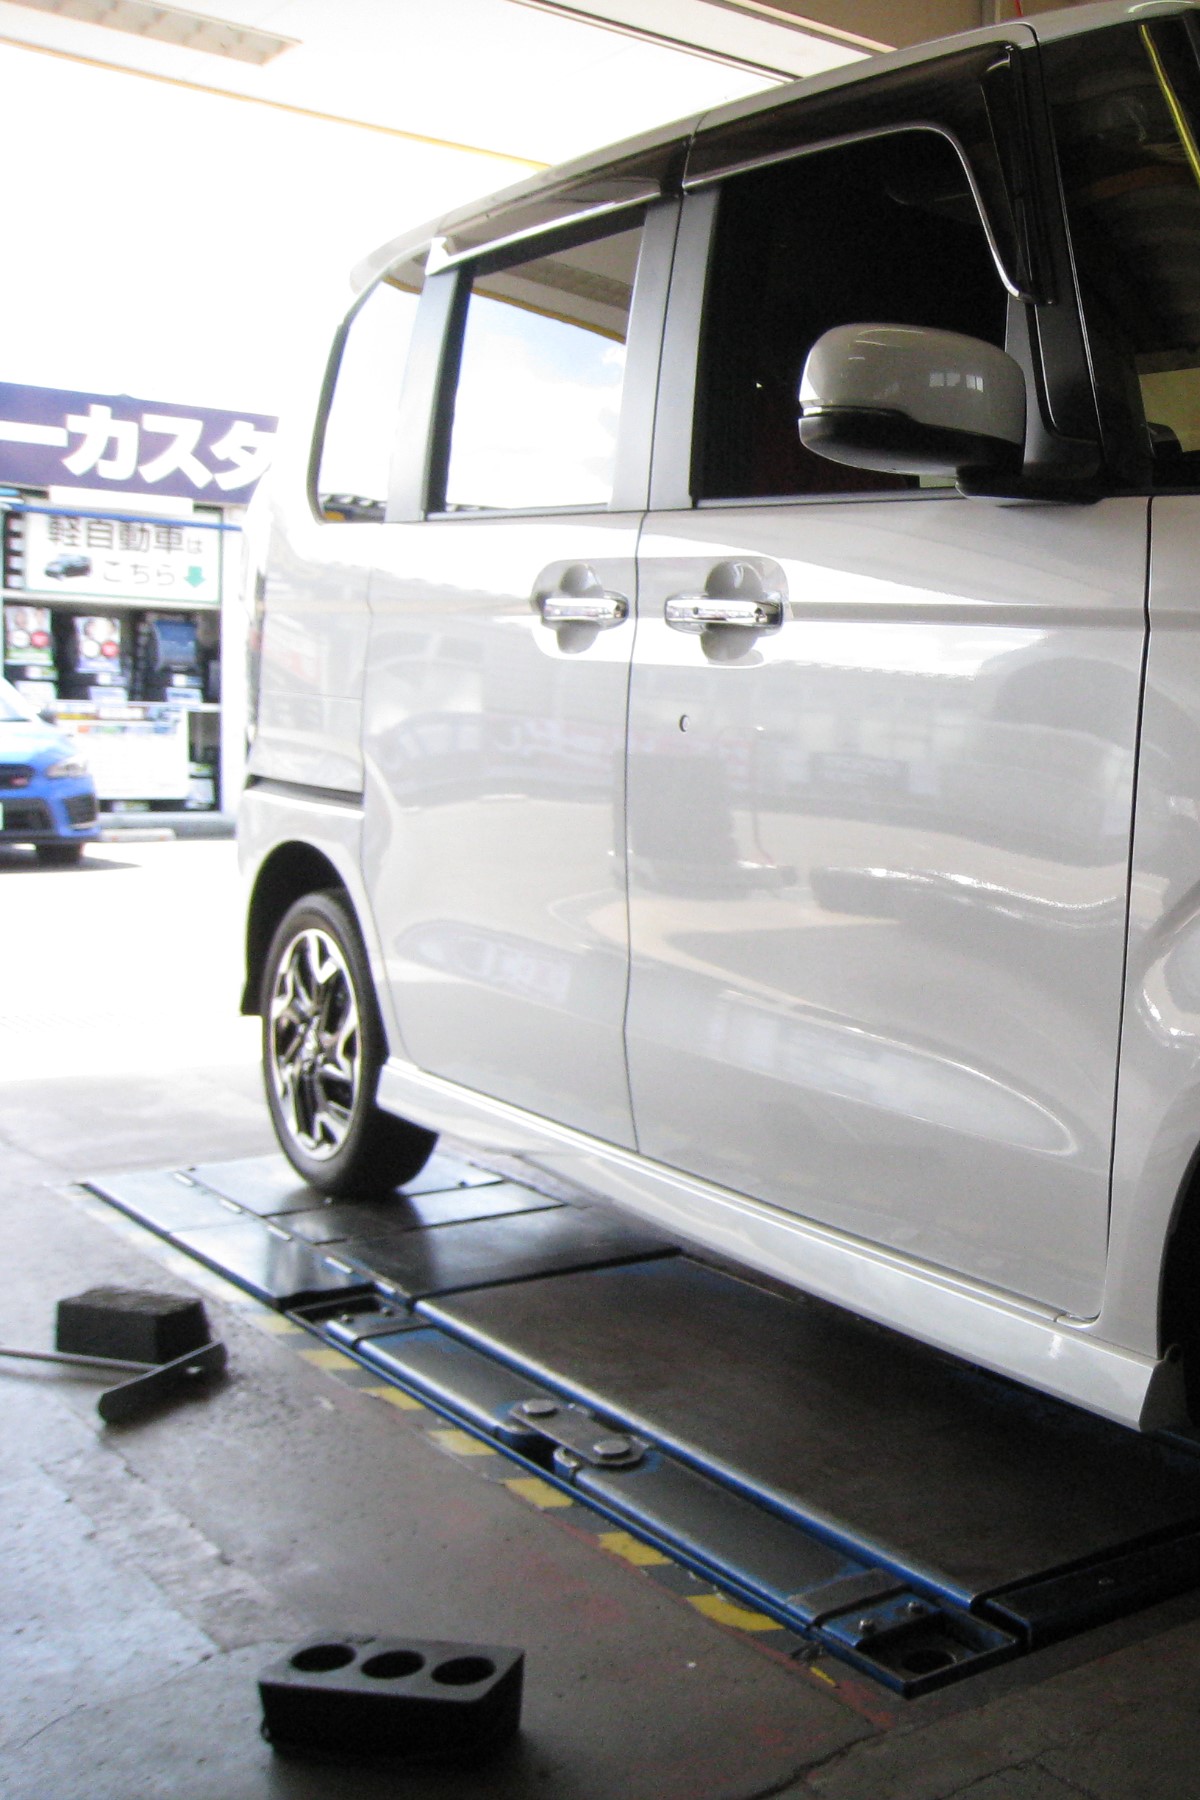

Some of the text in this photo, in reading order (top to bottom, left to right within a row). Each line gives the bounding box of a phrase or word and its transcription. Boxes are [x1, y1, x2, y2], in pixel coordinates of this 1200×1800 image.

[48, 516, 203, 554] 軽自動車は
[103, 560, 176, 587] こちら
